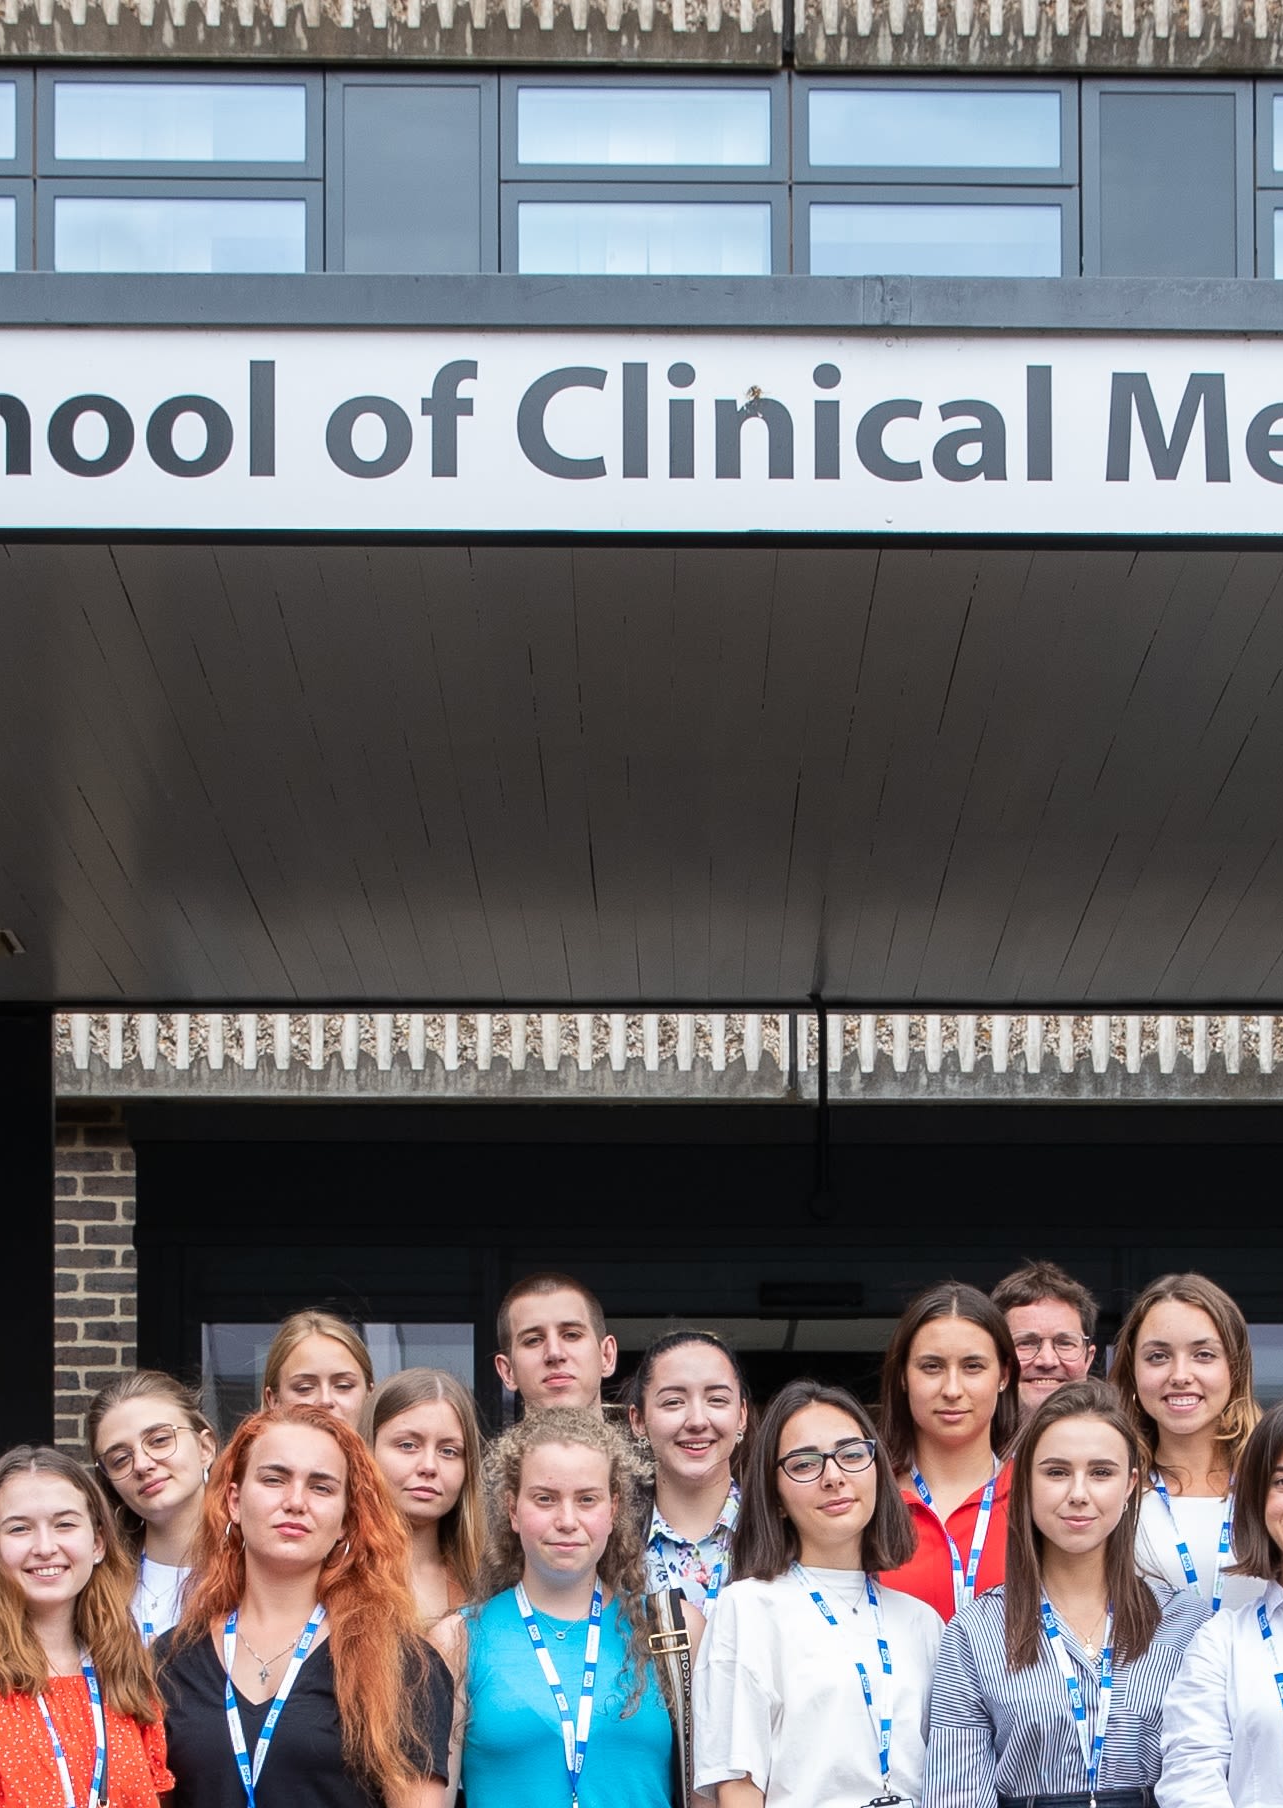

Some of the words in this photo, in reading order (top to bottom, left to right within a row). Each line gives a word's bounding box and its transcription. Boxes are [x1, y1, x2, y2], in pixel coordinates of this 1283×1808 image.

[325, 360, 478, 479] of
[516, 361, 1052, 482] Clinical
[1180, 1553, 1193, 1570] NHS
[528, 1624, 541, 1640] NHS
[584, 1671, 593, 1685] NHS
[680, 1651, 690, 1696] JACOB
[1069, 1688, 1082, 1707] NHS
[264, 1709, 277, 1727] NHS
[573, 1754, 583, 1772] NHS
[240, 1765, 251, 1784] NHS
